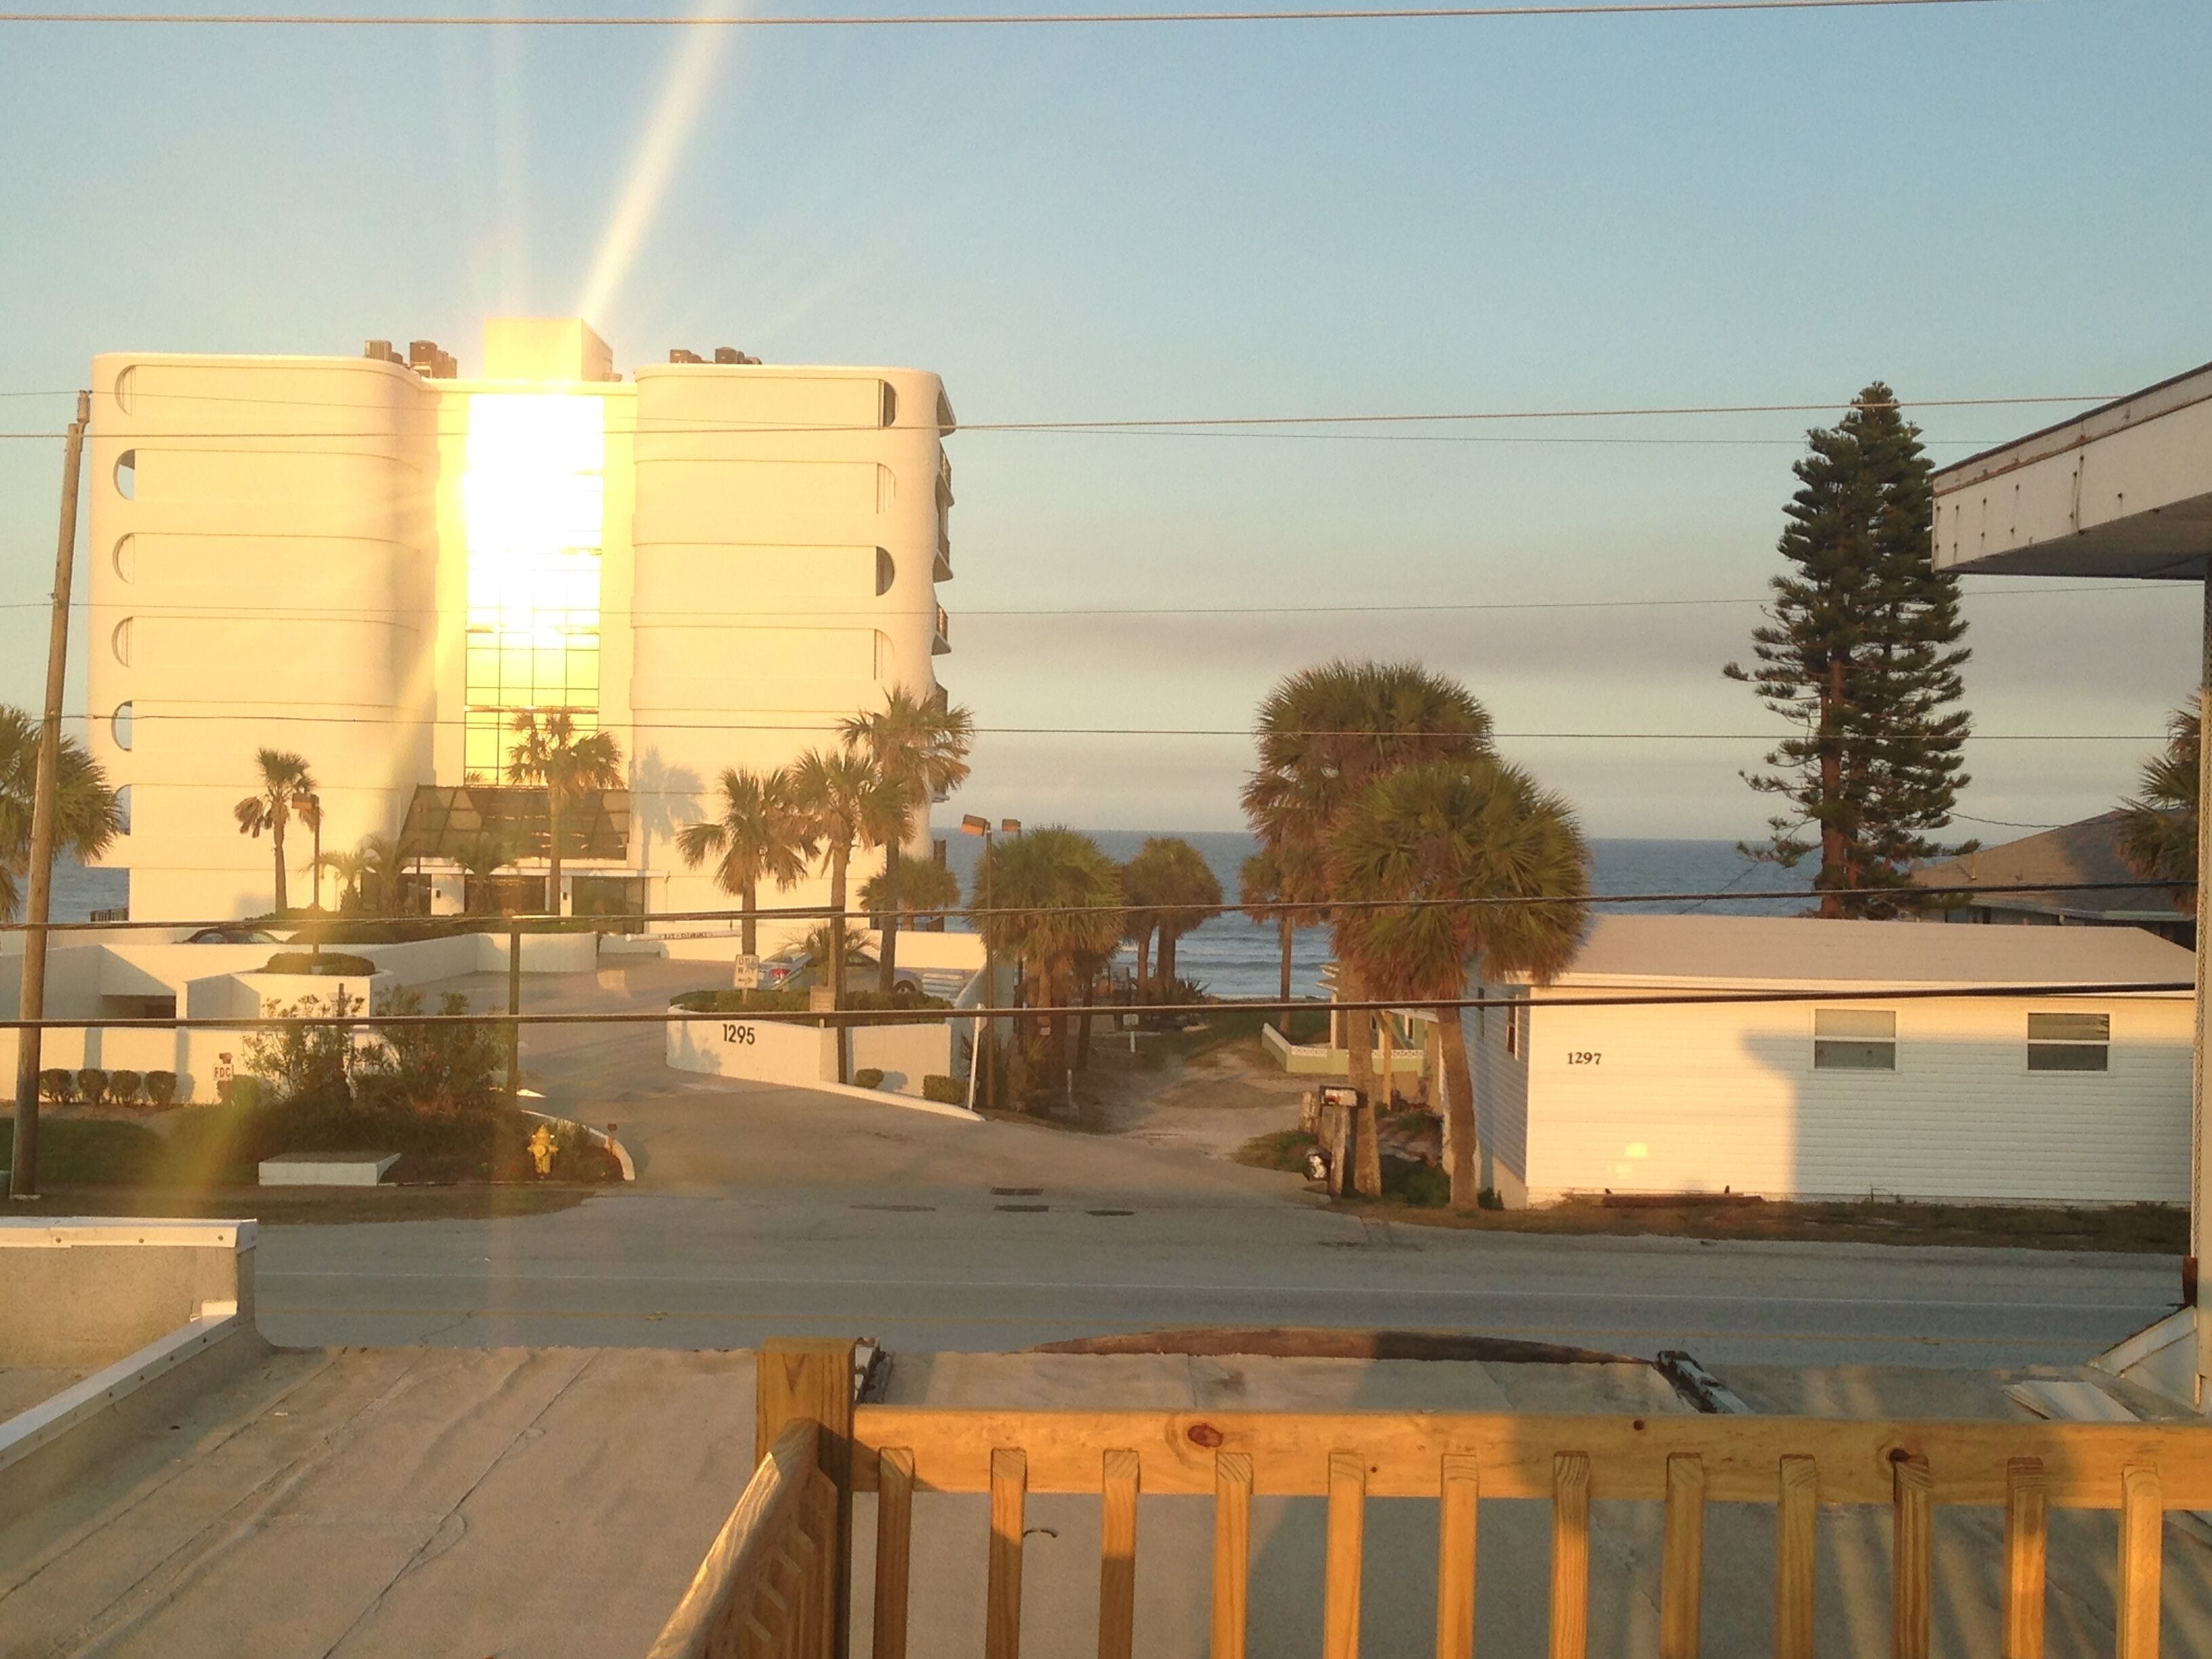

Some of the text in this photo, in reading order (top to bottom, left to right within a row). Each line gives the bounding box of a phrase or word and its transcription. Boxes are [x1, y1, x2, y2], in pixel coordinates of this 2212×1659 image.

[722, 1023, 755, 1045] 1295
[1567, 1052, 1602, 1065] 1297
[214, 1067, 230, 1078] FDC
